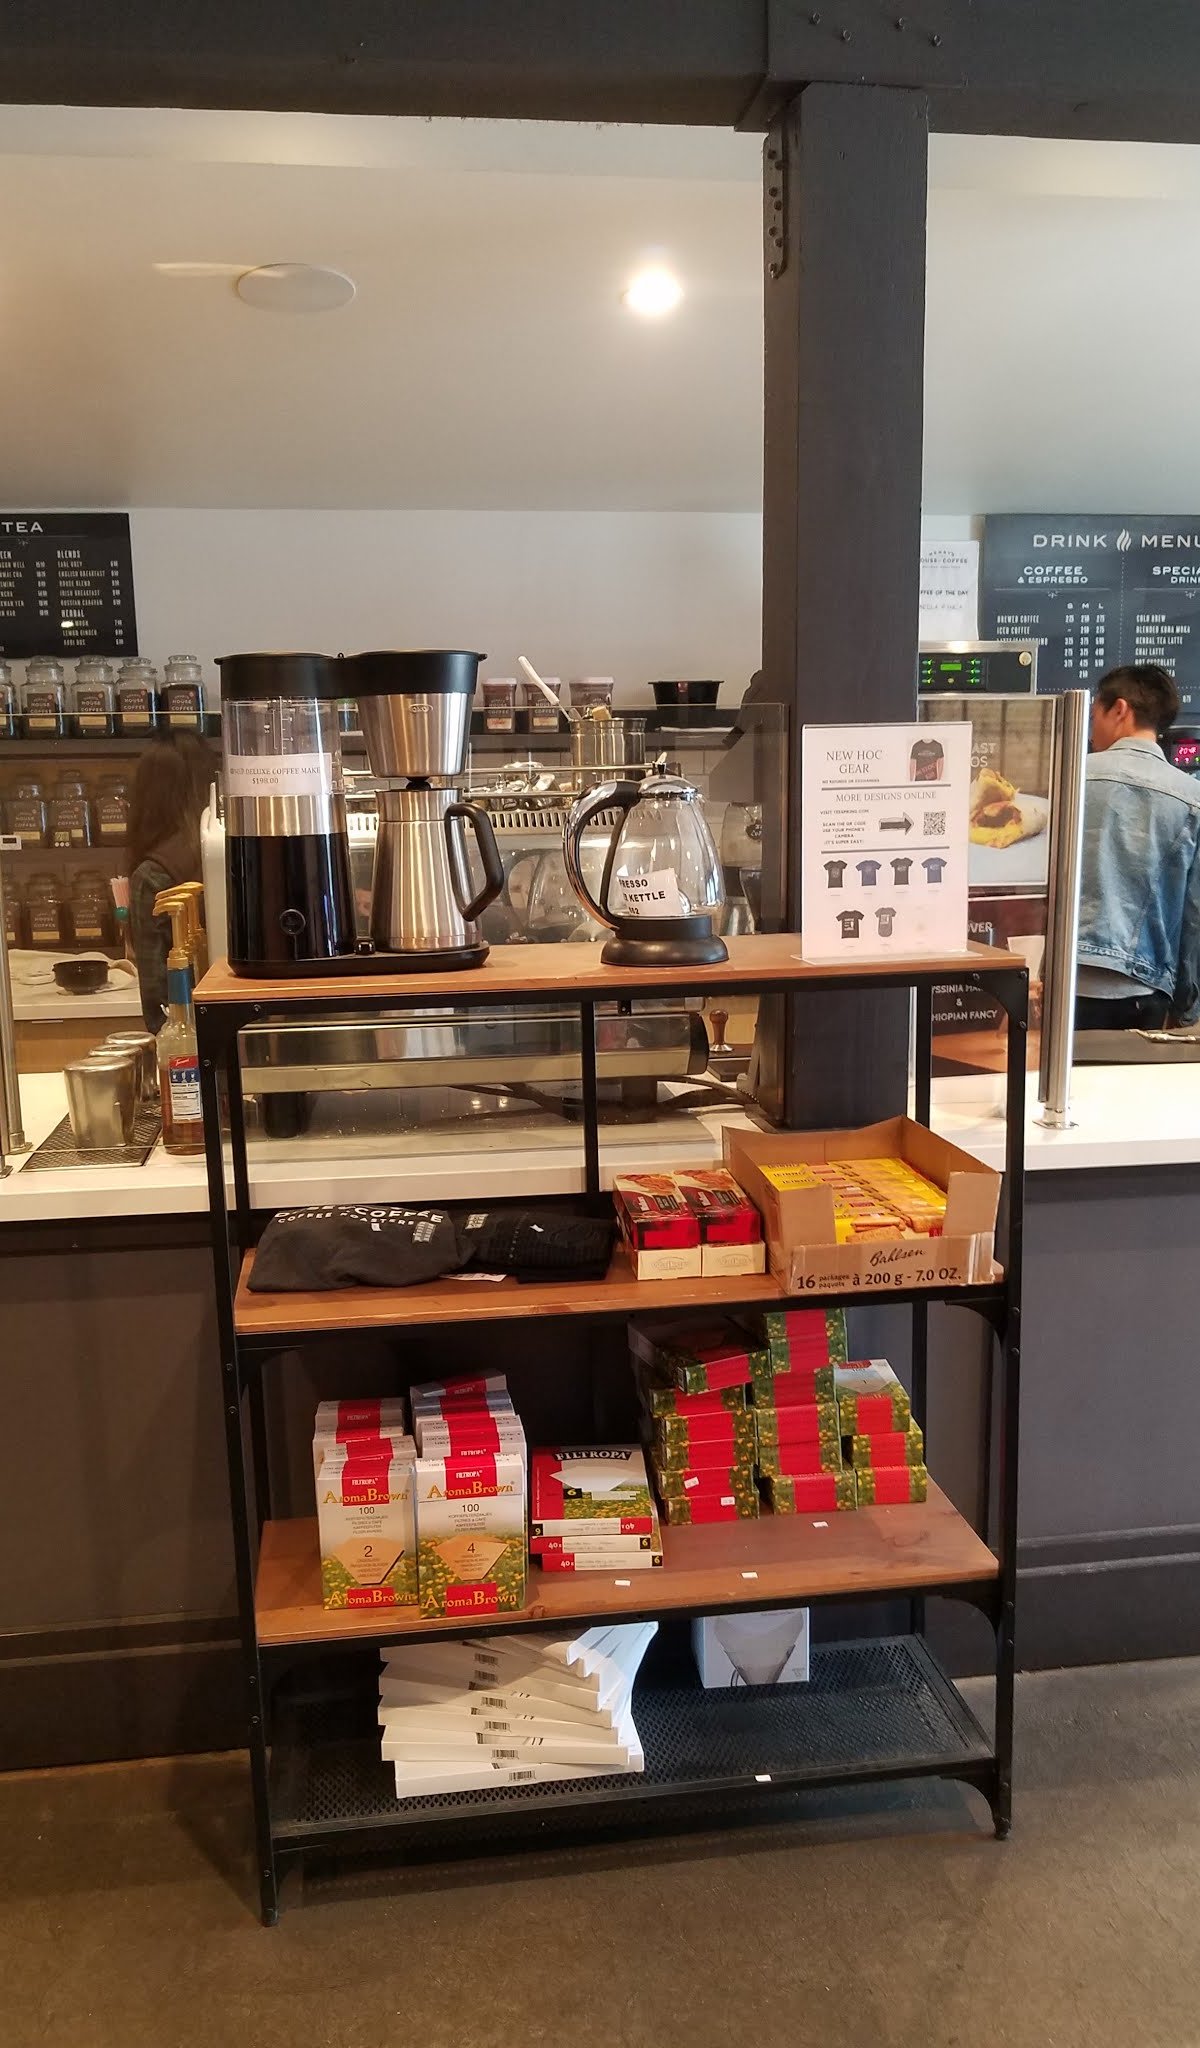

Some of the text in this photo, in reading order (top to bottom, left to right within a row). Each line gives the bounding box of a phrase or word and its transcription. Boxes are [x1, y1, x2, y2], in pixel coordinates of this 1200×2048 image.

[2, 522, 43, 533] TEA
[1033, 534, 1200, 548] DRINK MENU
[1024, 566, 1083, 575] COFFEE
[1028, 576, 1088, 584] ESPRESSO
[1082, 602, 1090, 610] M
[1020, 615, 1040, 624] COFFEE
[1011, 626, 1030, 635] COFFEE
[1157, 636, 1167, 645] TEA
[1167, 636, 1183, 645] LATTE
[1149, 648, 1165, 656] LATTE
[826, 749, 883, 761] NEW HOC
[272, 767, 299, 775] COFFEE
[839, 763, 870, 774] GEAR
[836, 791, 937, 802] MORE DESIGNS ONLINE
[629, 890, 666, 903] KETTLE
[956, 998, 963, 1007] &
[969, 1009, 998, 1020] FANCY
[278, 1211, 333, 1224] COFFEE
[354, 1206, 444, 1223] COFFEE
[869, 1247, 927, 1267] Bahlsen
[797, 1274, 816, 1290] 16
[852, 1273, 861, 1287] à
[864, 1272, 891, 1285] 200
[894, 1273, 904, 1286] g
[916, 1269, 935, 1282] 7.0
[938, 1267, 962, 1280] OZ.
[818, 1274, 850, 1282] packages
[555, 1450, 627, 1461] FILTROPA
[456, 1471, 480, 1479] FILTROPA
[352, 1478, 376, 1486] FILTROPA
[427, 1481, 513, 1499] AromaBrown
[322, 1488, 408, 1504] AromaBrown
[359, 1506, 375, 1515] 100
[462, 1503, 480, 1513] 100
[548, 1541, 558, 1550] 40
[642, 1538, 648, 1547] 6
[364, 1545, 373, 1558] 2
[467, 1542, 476, 1554] 4
[561, 1559, 571, 1569] 40
[654, 1555, 661, 1564] 6
[329, 1589, 415, 1605] AromaBrown
[424, 1590, 518, 1609] AromaBrown
